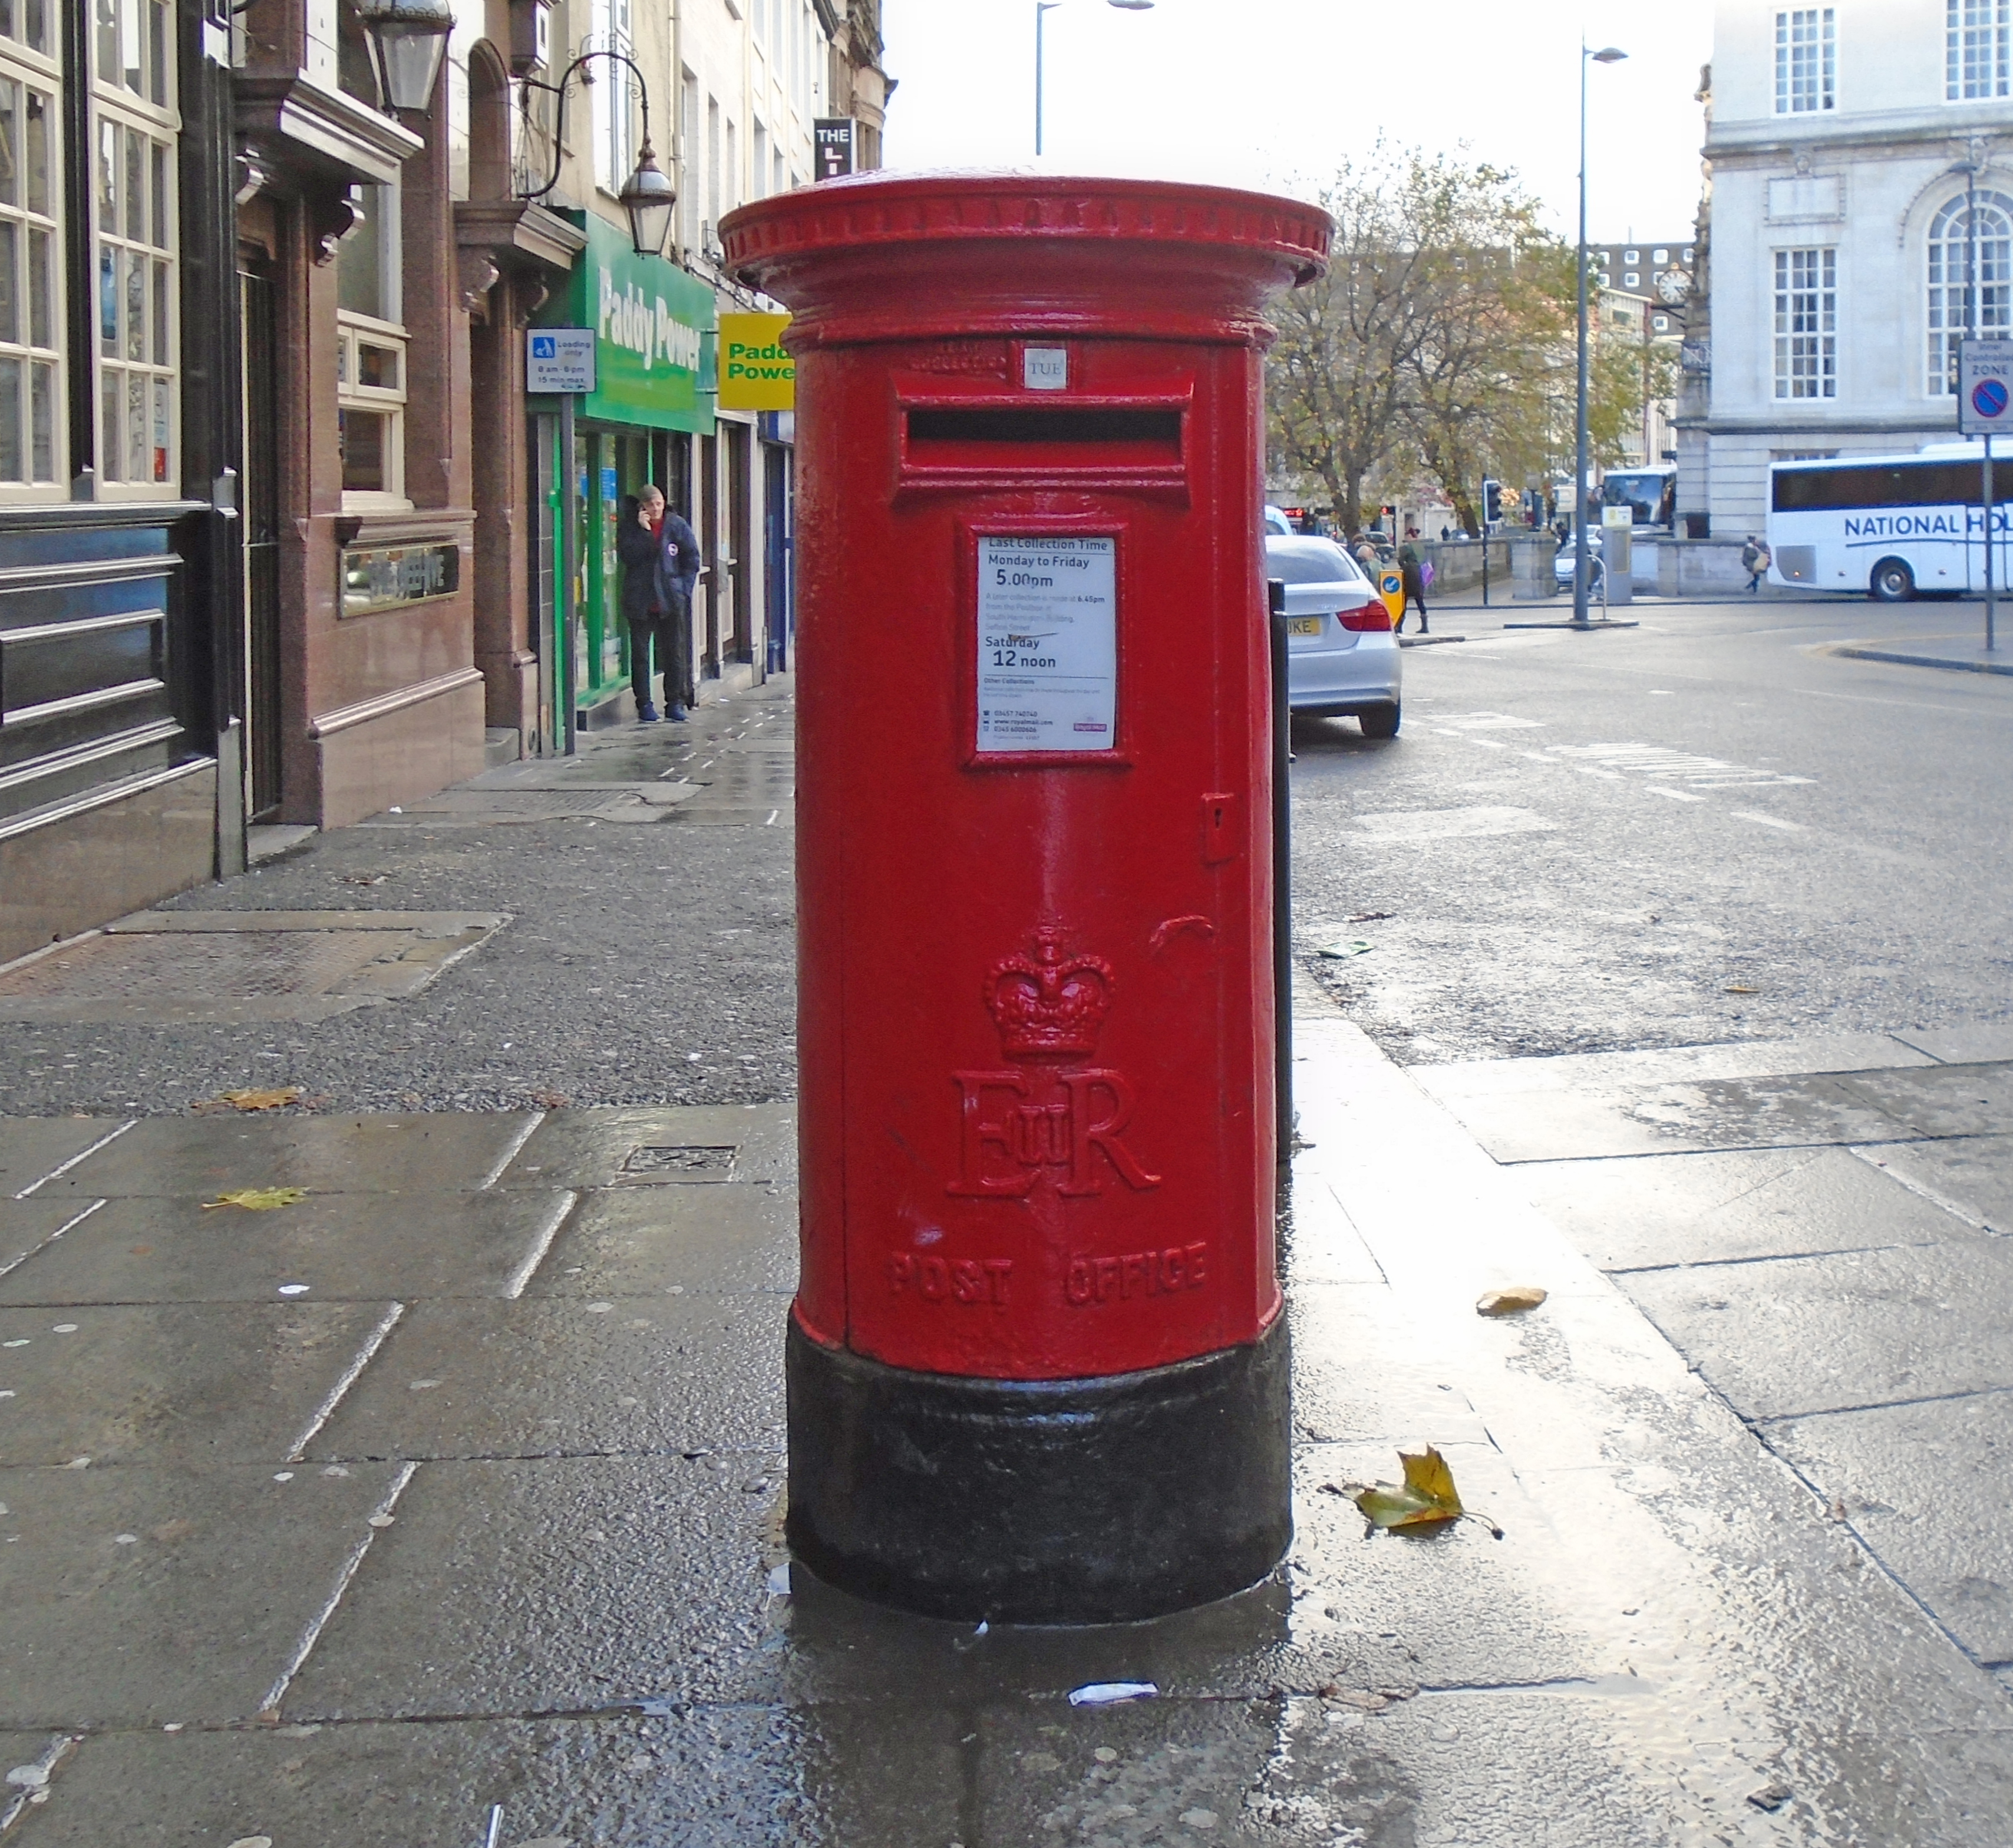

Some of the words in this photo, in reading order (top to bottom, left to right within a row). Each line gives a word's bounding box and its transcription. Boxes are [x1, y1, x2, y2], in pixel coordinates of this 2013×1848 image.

[817, 129, 849, 142] THE
[599, 266, 654, 371] Paddy
[655, 296, 701, 372] Power
[1030, 362, 1061, 375] TUE
[1973, 365, 2009, 375] ZONE
[1845, 514, 1960, 536] NATIONAL
[989, 537, 1015, 548] Last
[1017, 538, 1075, 549] Collection
[1078, 540, 1108, 550] Time
[989, 555, 1034, 567] Monday
[1037, 557, 1050, 566] to
[1052, 556, 1090, 569] Friday
[996, 569, 1054, 589] 5.00pm
[1077, 595, 1105, 604] 6.45pm
[985, 636, 1040, 649] Saturday
[993, 650, 1016, 666] 12
[1021, 658, 1056, 667] noon
[892, 1250, 1013, 1306] POST
[1065, 1241, 1207, 1306] OFFICE
